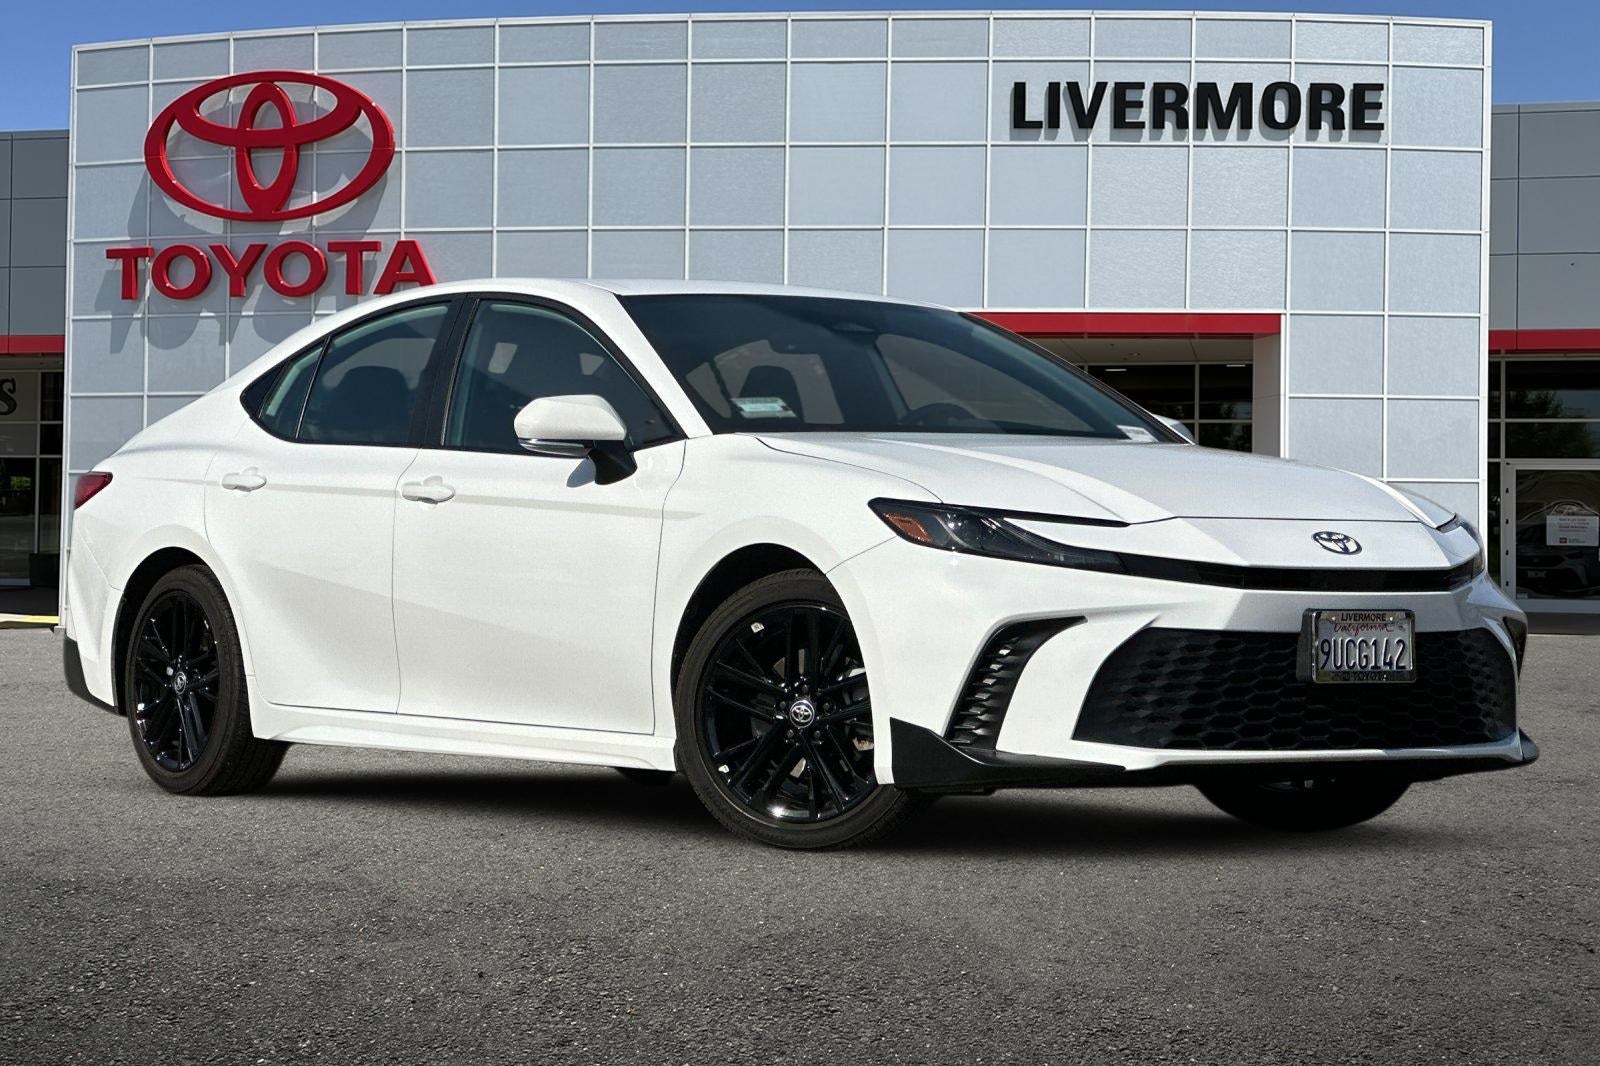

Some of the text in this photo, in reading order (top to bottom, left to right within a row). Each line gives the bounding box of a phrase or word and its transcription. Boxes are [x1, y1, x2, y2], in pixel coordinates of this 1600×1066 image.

[1012, 81, 1385, 131] LIVERMORE
[105, 239, 436, 300] TOYOTA
[1333, 622, 1394, 636] California
[1341, 612, 1387, 622] LIVERMORE
[1320, 637, 1406, 670] 9UCG142
